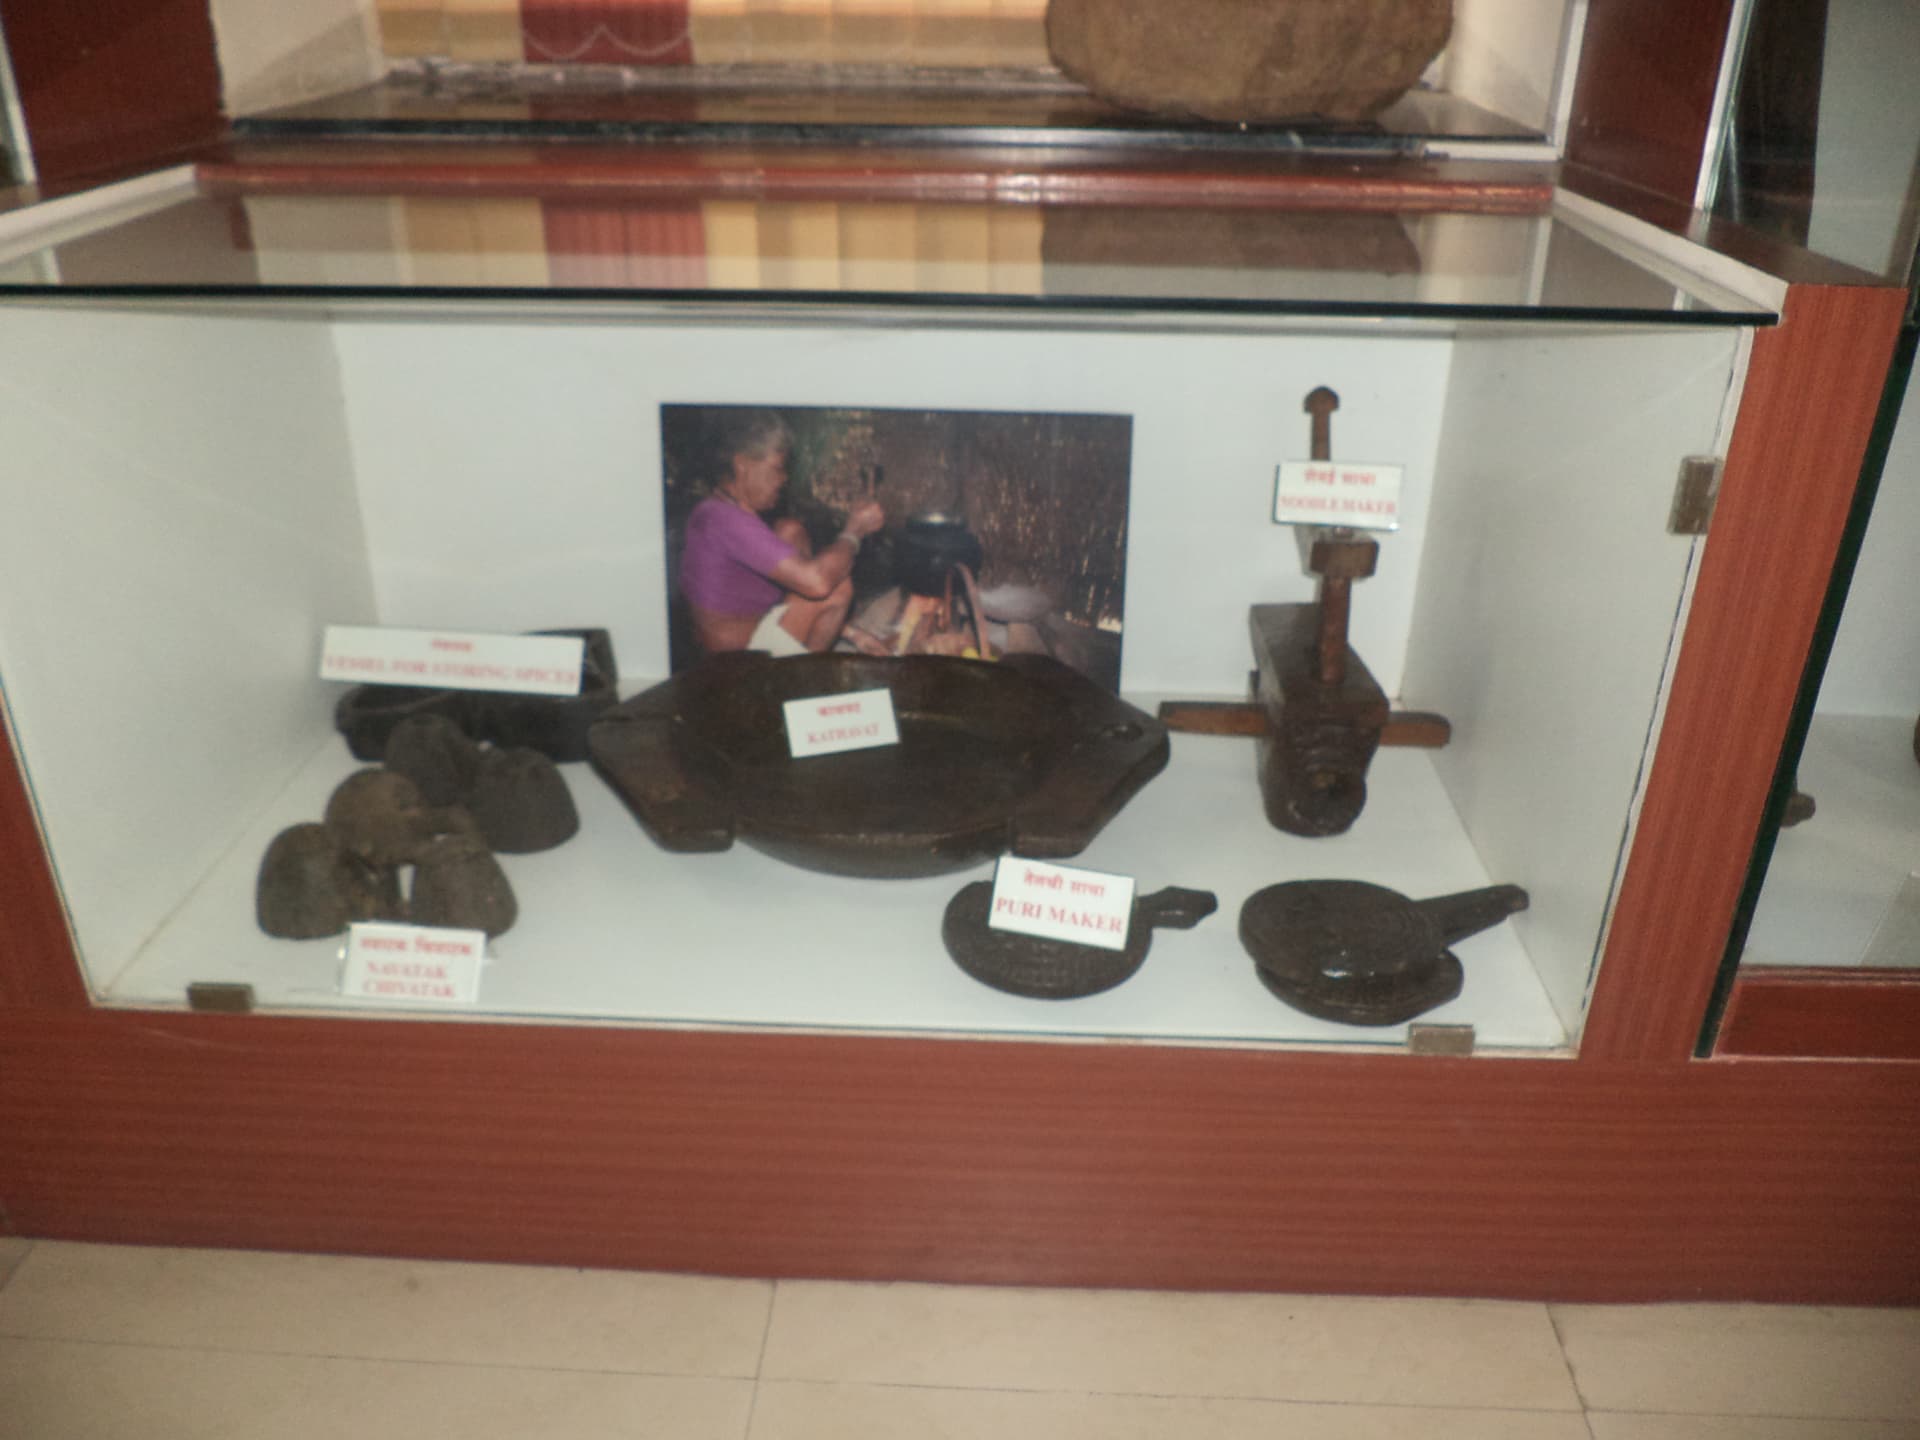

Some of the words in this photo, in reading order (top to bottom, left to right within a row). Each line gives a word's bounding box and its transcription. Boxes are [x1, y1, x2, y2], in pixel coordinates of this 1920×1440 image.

[1343, 498, 1396, 513] MAKER
[391, 660, 428, 674] FOR
[995, 896, 1042, 919] PURI
[1049, 904, 1123, 934] MAKER
